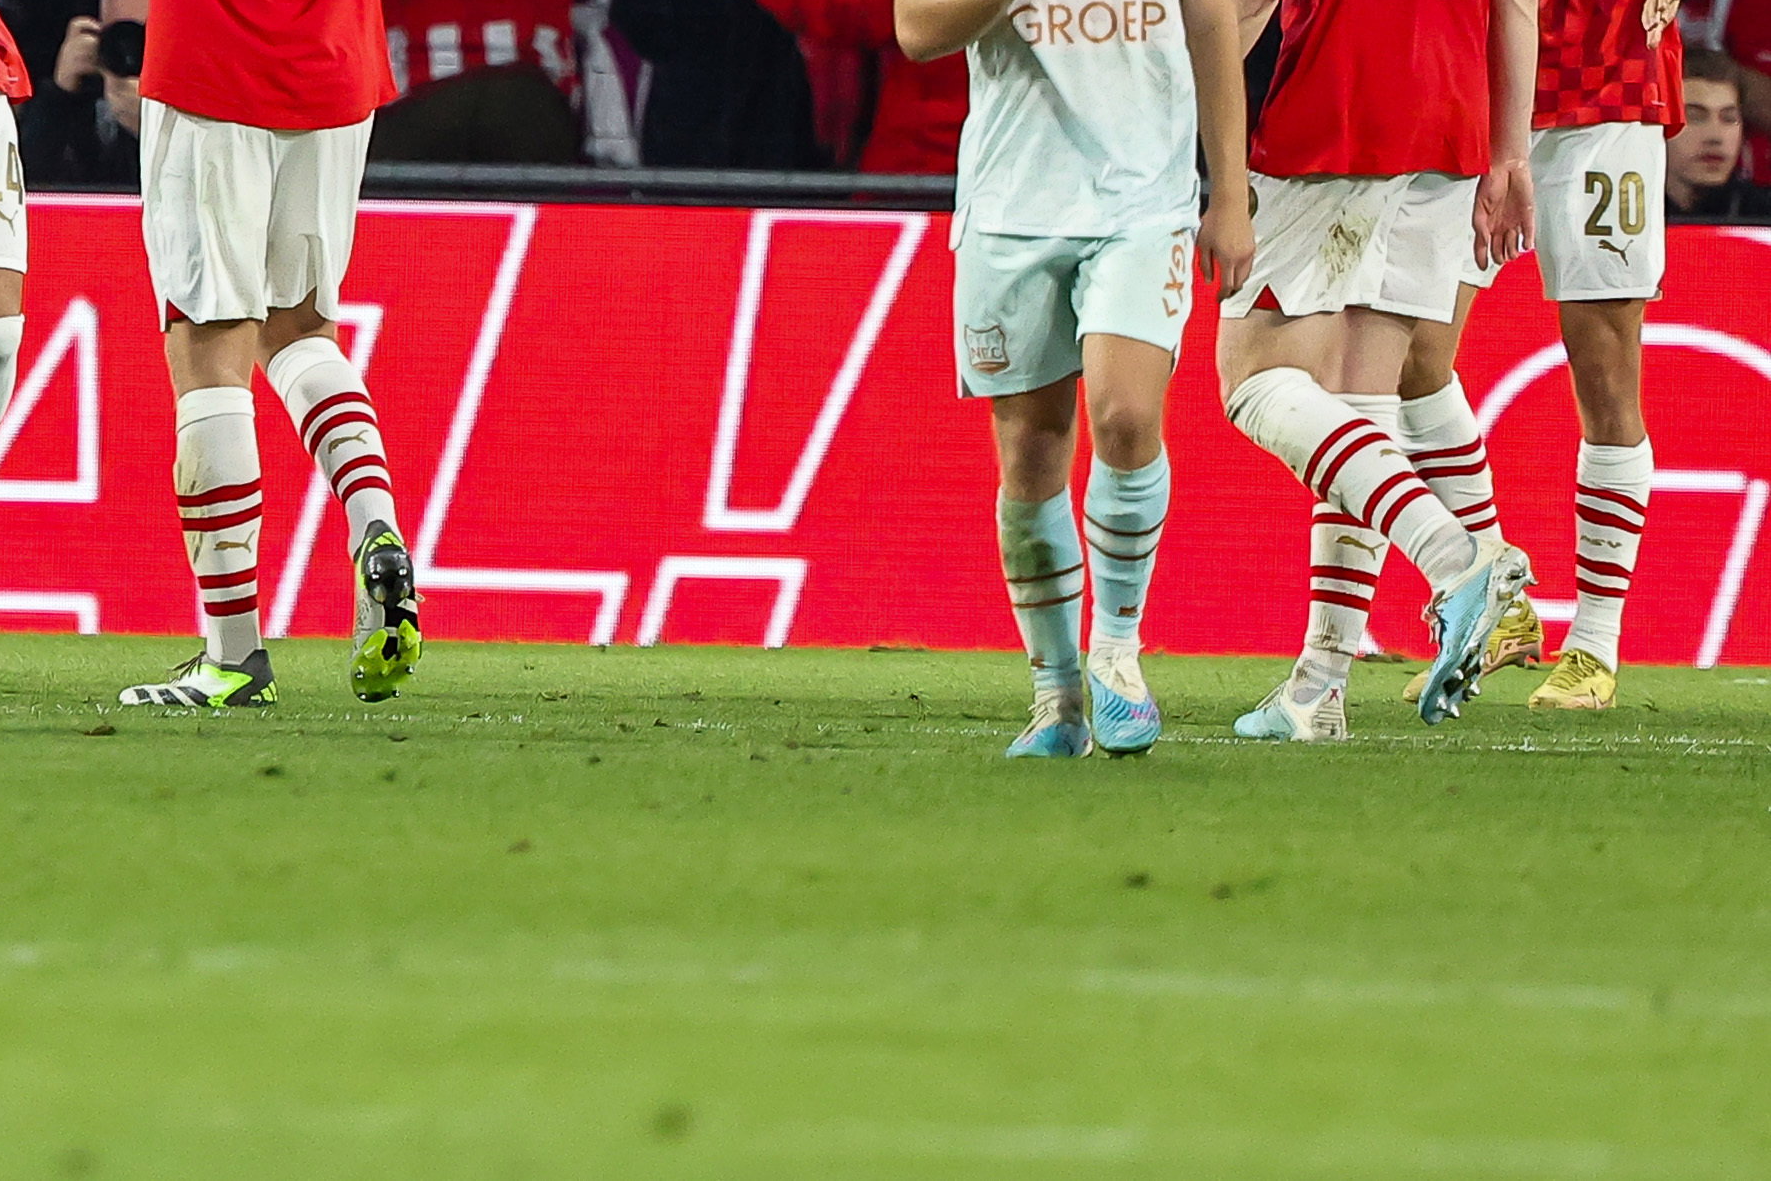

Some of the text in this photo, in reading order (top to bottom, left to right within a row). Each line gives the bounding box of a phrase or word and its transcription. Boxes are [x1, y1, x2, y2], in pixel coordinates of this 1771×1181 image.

[1008, 0, 1167, 45] GROEP
[1583, 170, 1646, 237] 20
[971, 347, 1003, 360] NEC
